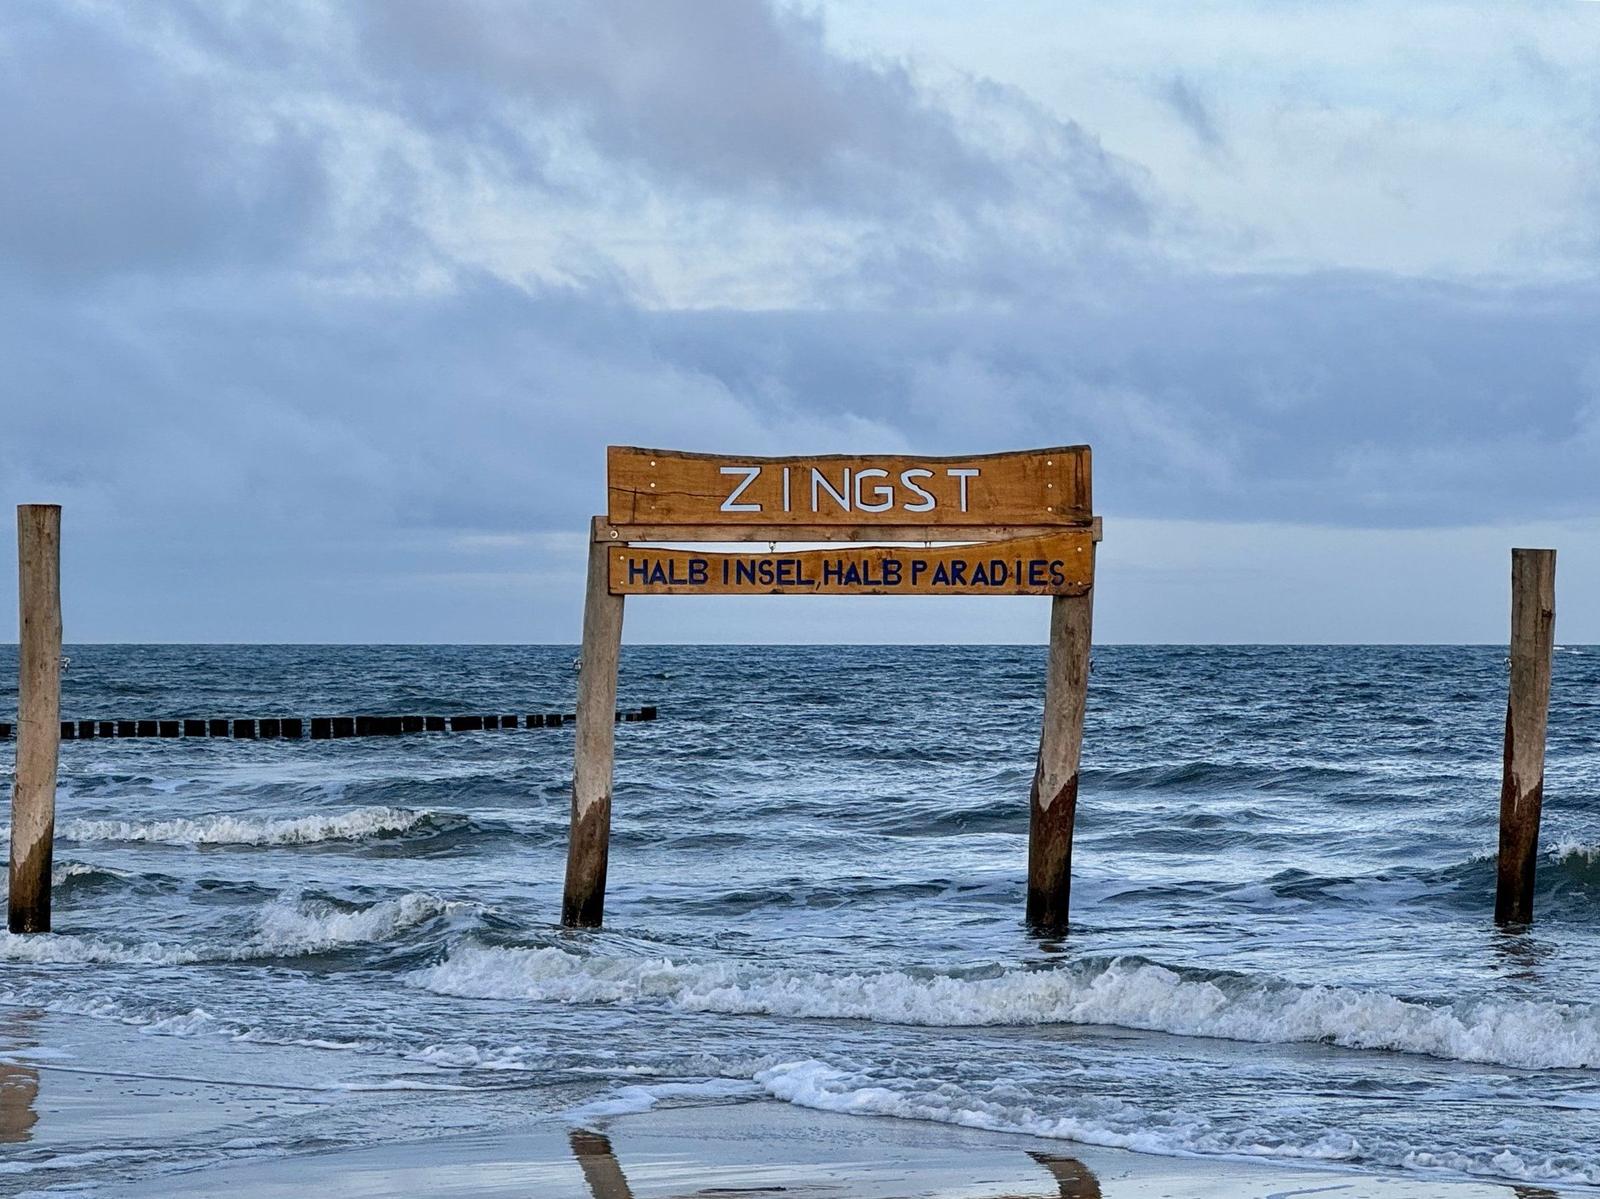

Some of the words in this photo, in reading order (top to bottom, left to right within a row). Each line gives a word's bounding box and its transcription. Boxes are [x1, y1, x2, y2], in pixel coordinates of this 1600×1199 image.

[719, 466, 980, 513] ZINGST
[628, 558, 708, 586] HALB
[823, 559, 902, 586] HALB
